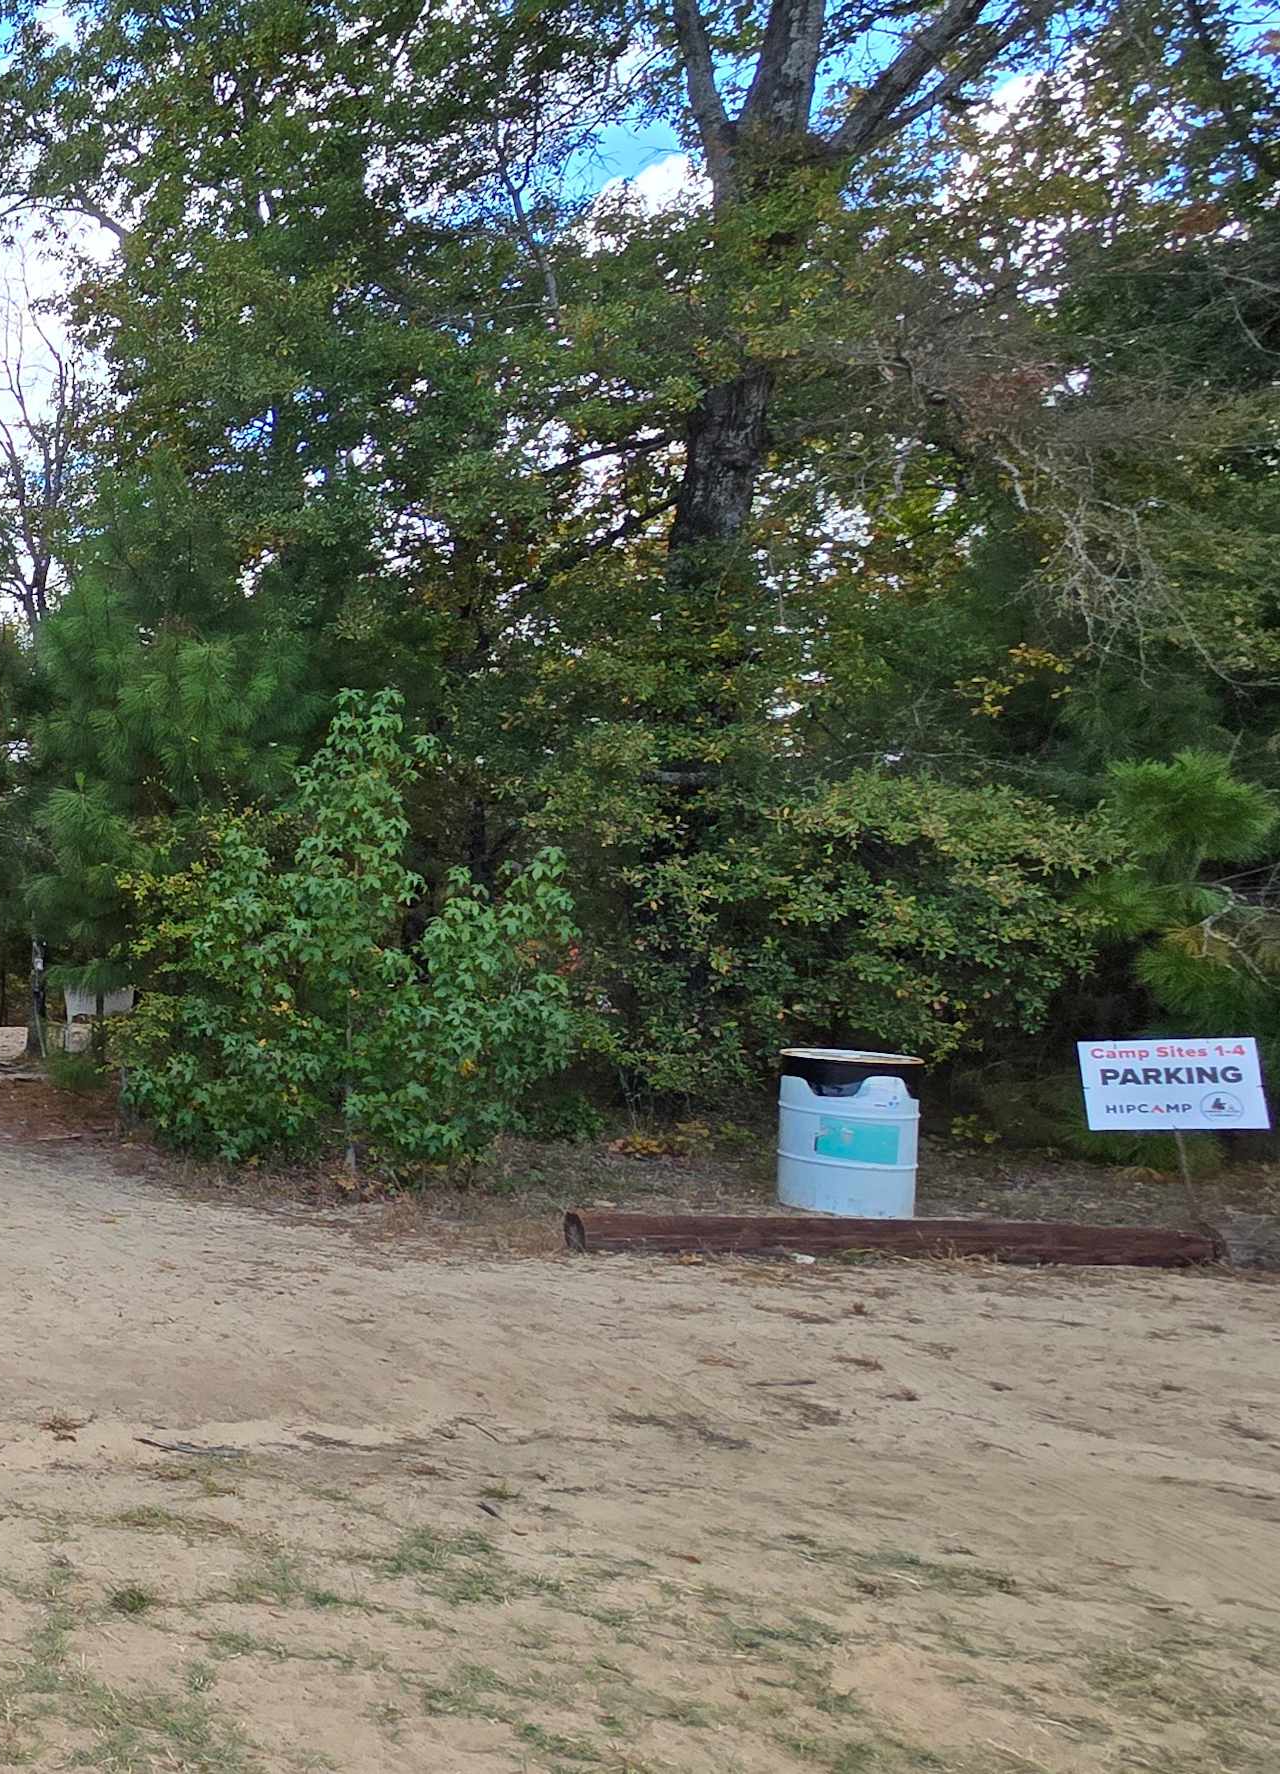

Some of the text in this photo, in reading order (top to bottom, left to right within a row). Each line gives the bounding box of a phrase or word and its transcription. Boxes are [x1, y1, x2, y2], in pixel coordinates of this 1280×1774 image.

[1091, 1044, 1246, 1061] Camp Sites 1-4
[1099, 1066, 1243, 1086] PARKING
[1105, 1103, 1193, 1114] HIPCAMP
